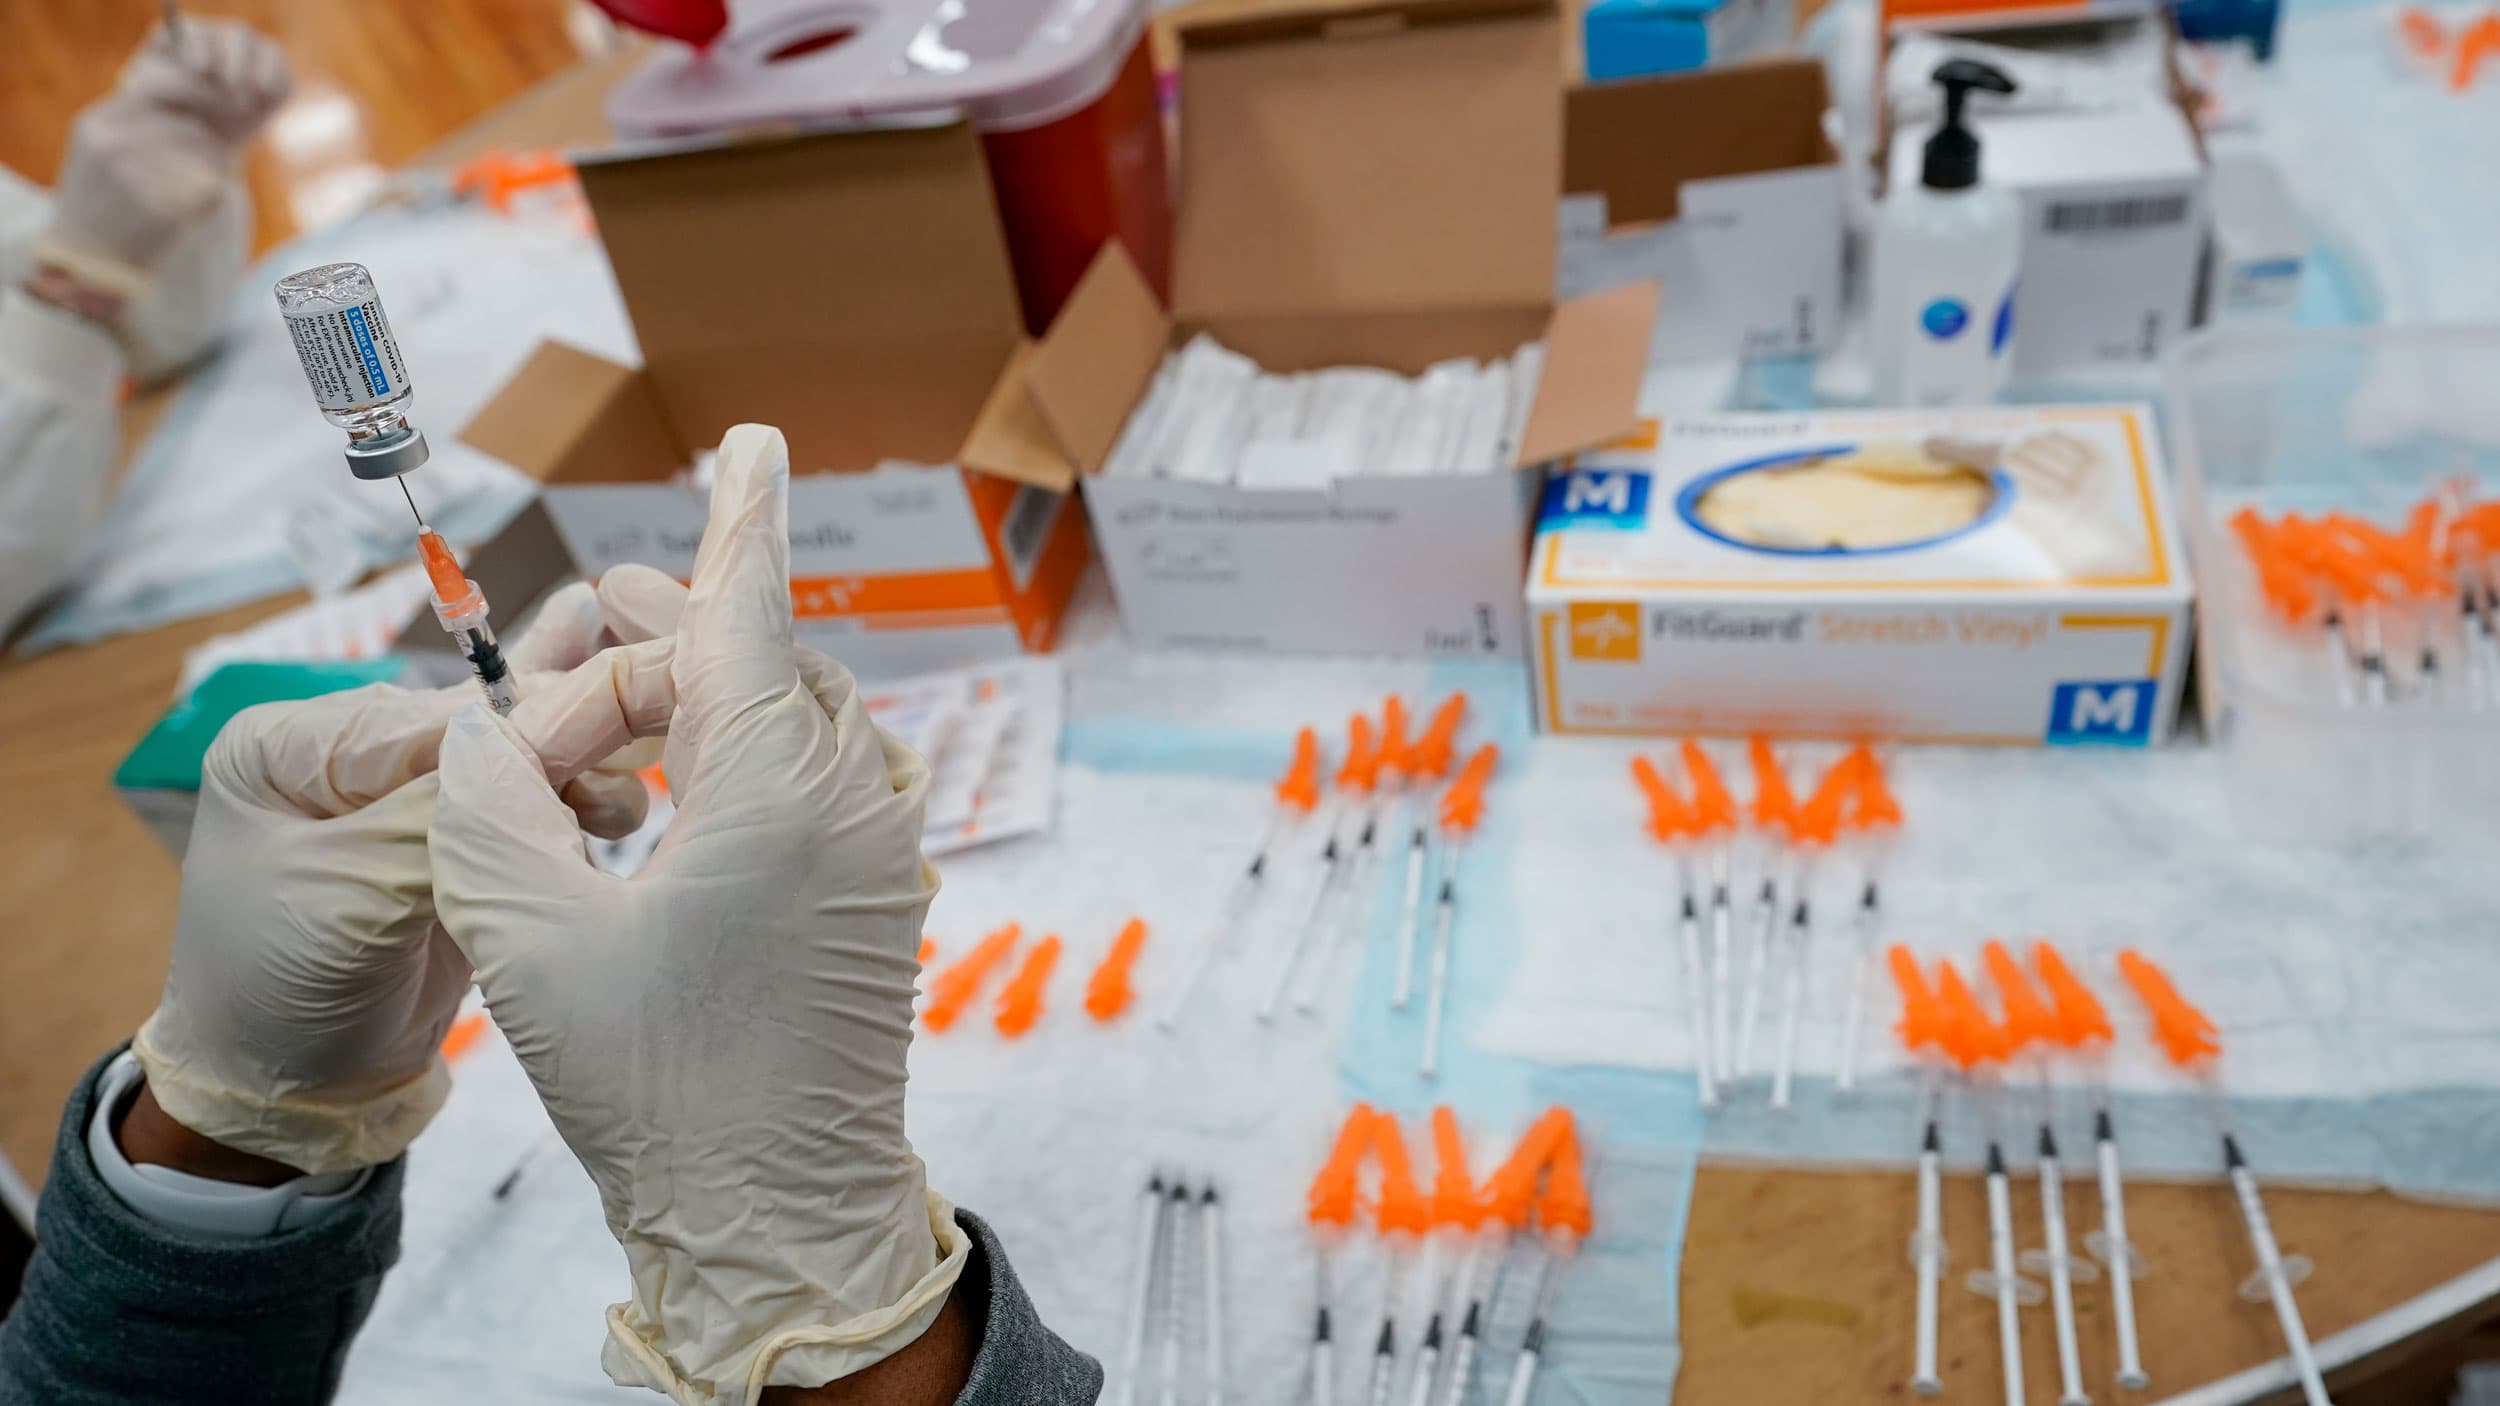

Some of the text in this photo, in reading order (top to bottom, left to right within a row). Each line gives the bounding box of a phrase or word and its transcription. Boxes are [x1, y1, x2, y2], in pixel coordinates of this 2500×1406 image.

[361, 303, 379, 341] Vaccine
[368, 300, 385, 338] Janssen
[382, 339, 402, 384] COVID-19
[303, 345, 313, 363] after
[307, 316, 318, 336] After
[314, 335, 324, 351] first
[320, 352, 329, 366] use,
[326, 367, 337, 383] hold
[317, 315, 355, 403] For EXP: www.vaxcheck.jnj
[332, 325, 352, 369] Preservative
[338, 310, 375, 399] Intramuscular Injection
[353, 318, 369, 347] doses
[369, 360, 379, 375] 0.5
[1563, 475, 1629, 514] M
[1652, 613, 2048, 650] FitGuard Stretch Vinyl
[2069, 689, 2139, 732] M
